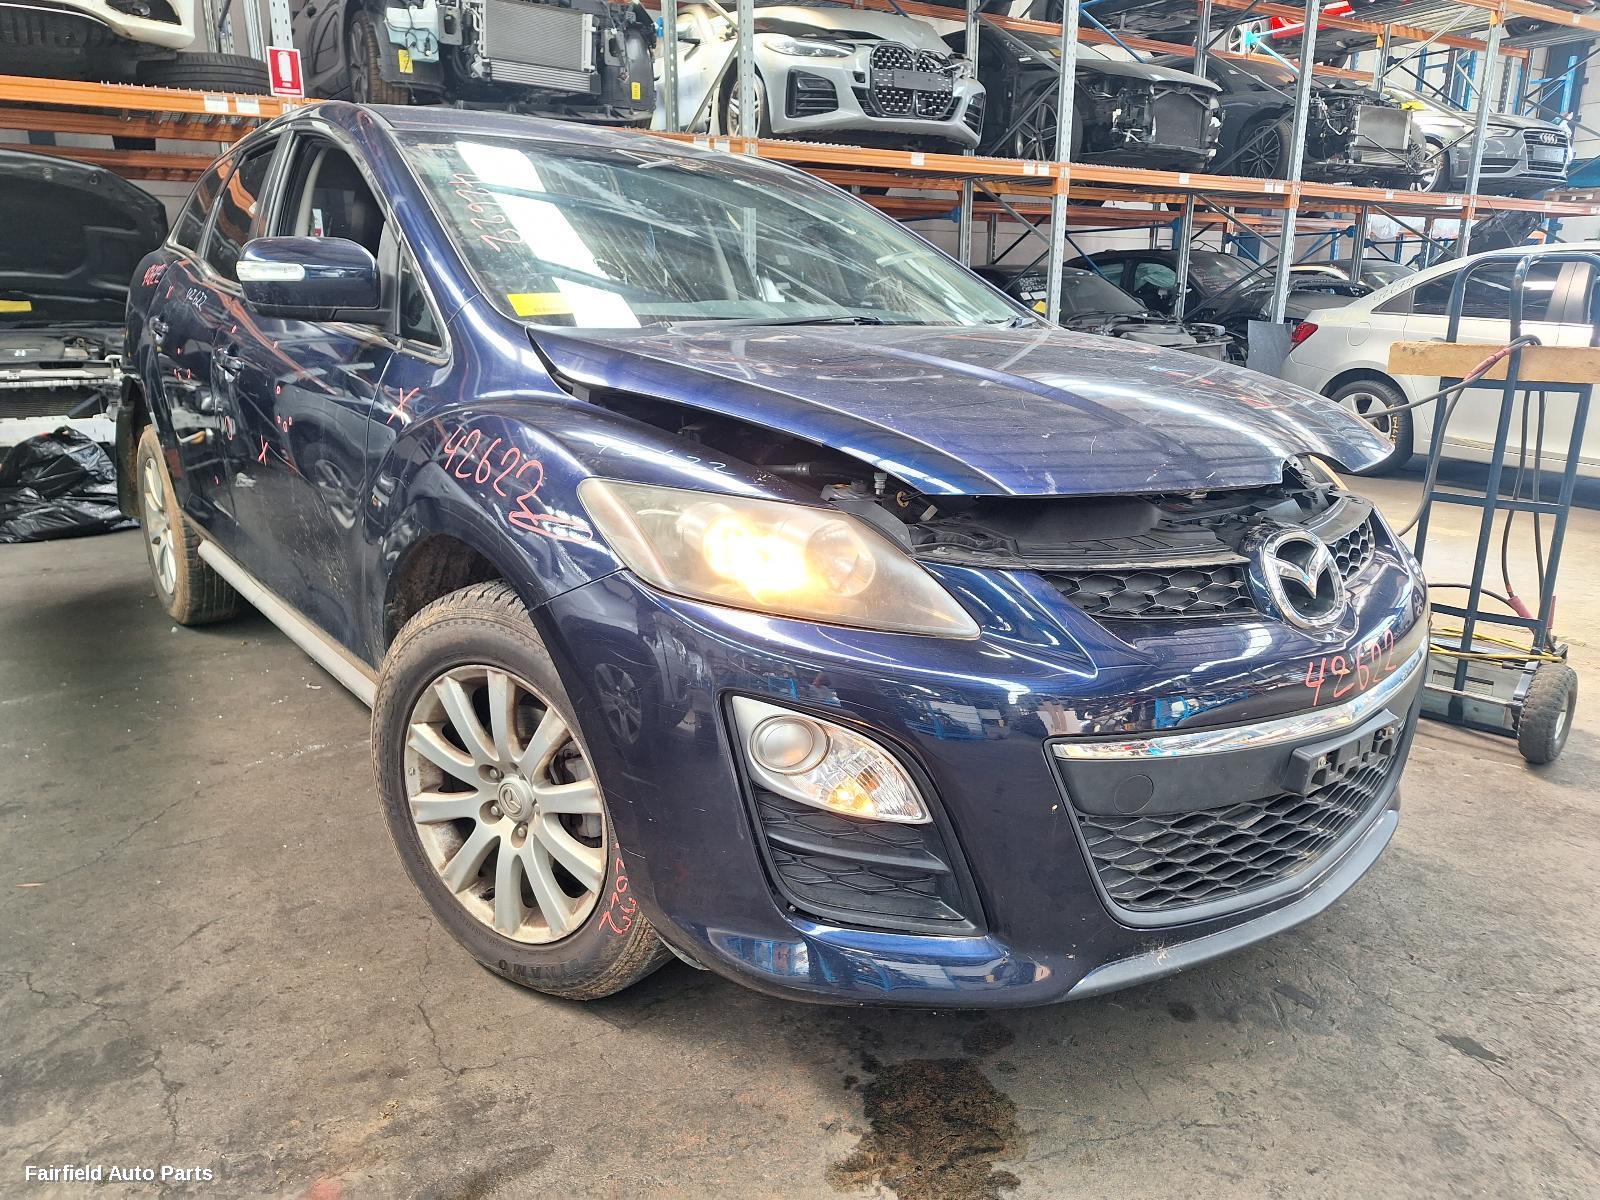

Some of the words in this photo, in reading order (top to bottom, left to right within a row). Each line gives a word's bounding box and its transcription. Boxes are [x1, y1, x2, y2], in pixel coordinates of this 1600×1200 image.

[448, 173, 522, 252] 42622
[184, 287, 208, 312] 42622
[444, 425, 545, 526] 42622
[1305, 629, 1397, 707] 42622
